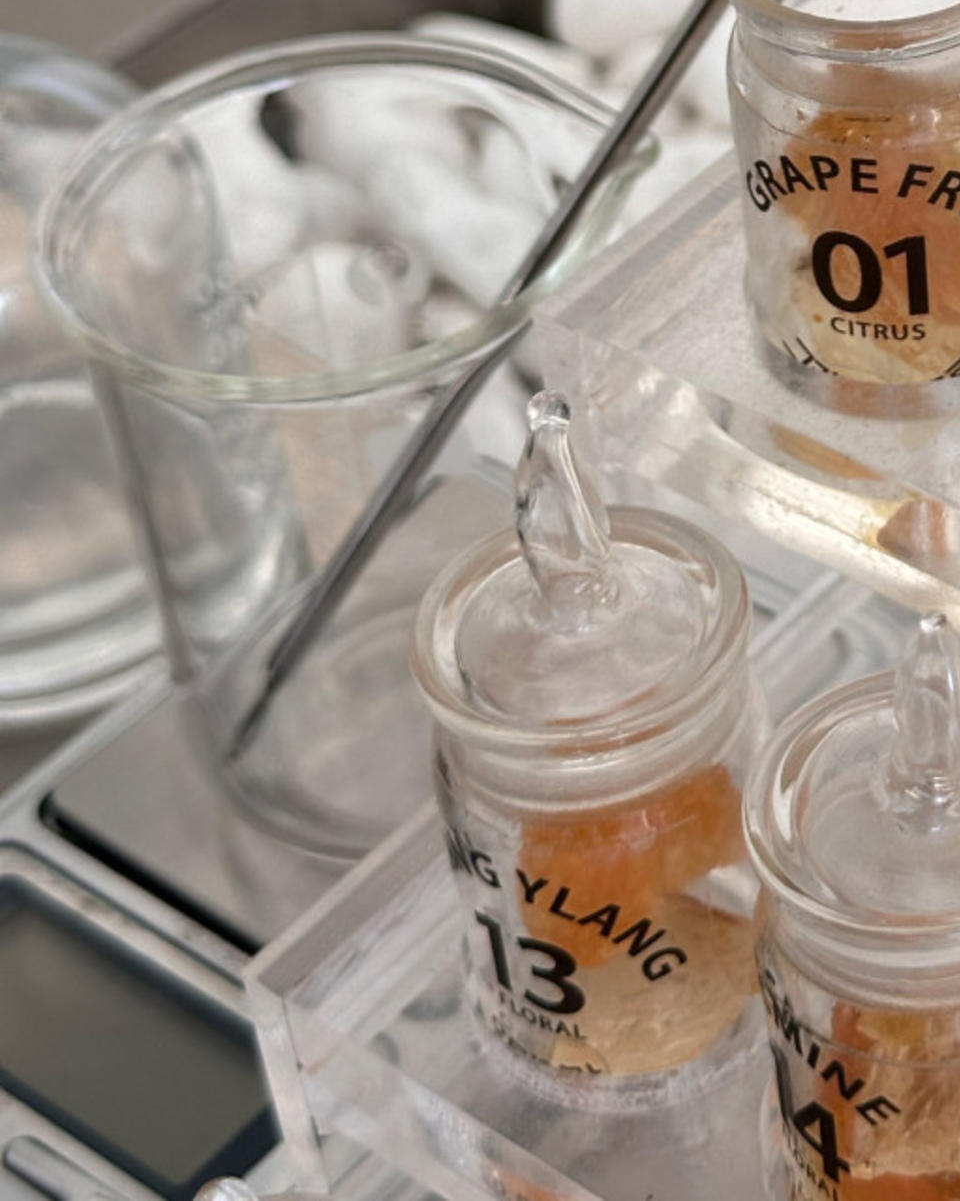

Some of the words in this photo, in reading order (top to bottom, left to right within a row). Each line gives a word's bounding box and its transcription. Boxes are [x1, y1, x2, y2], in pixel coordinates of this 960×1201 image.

[746, 155, 879, 212] GRAPE
[811, 230, 930, 316] 01
[830, 316, 926, 341] CITRUS
[474, 910, 586, 1015] 13
[515, 868, 687, 983] YLANG
